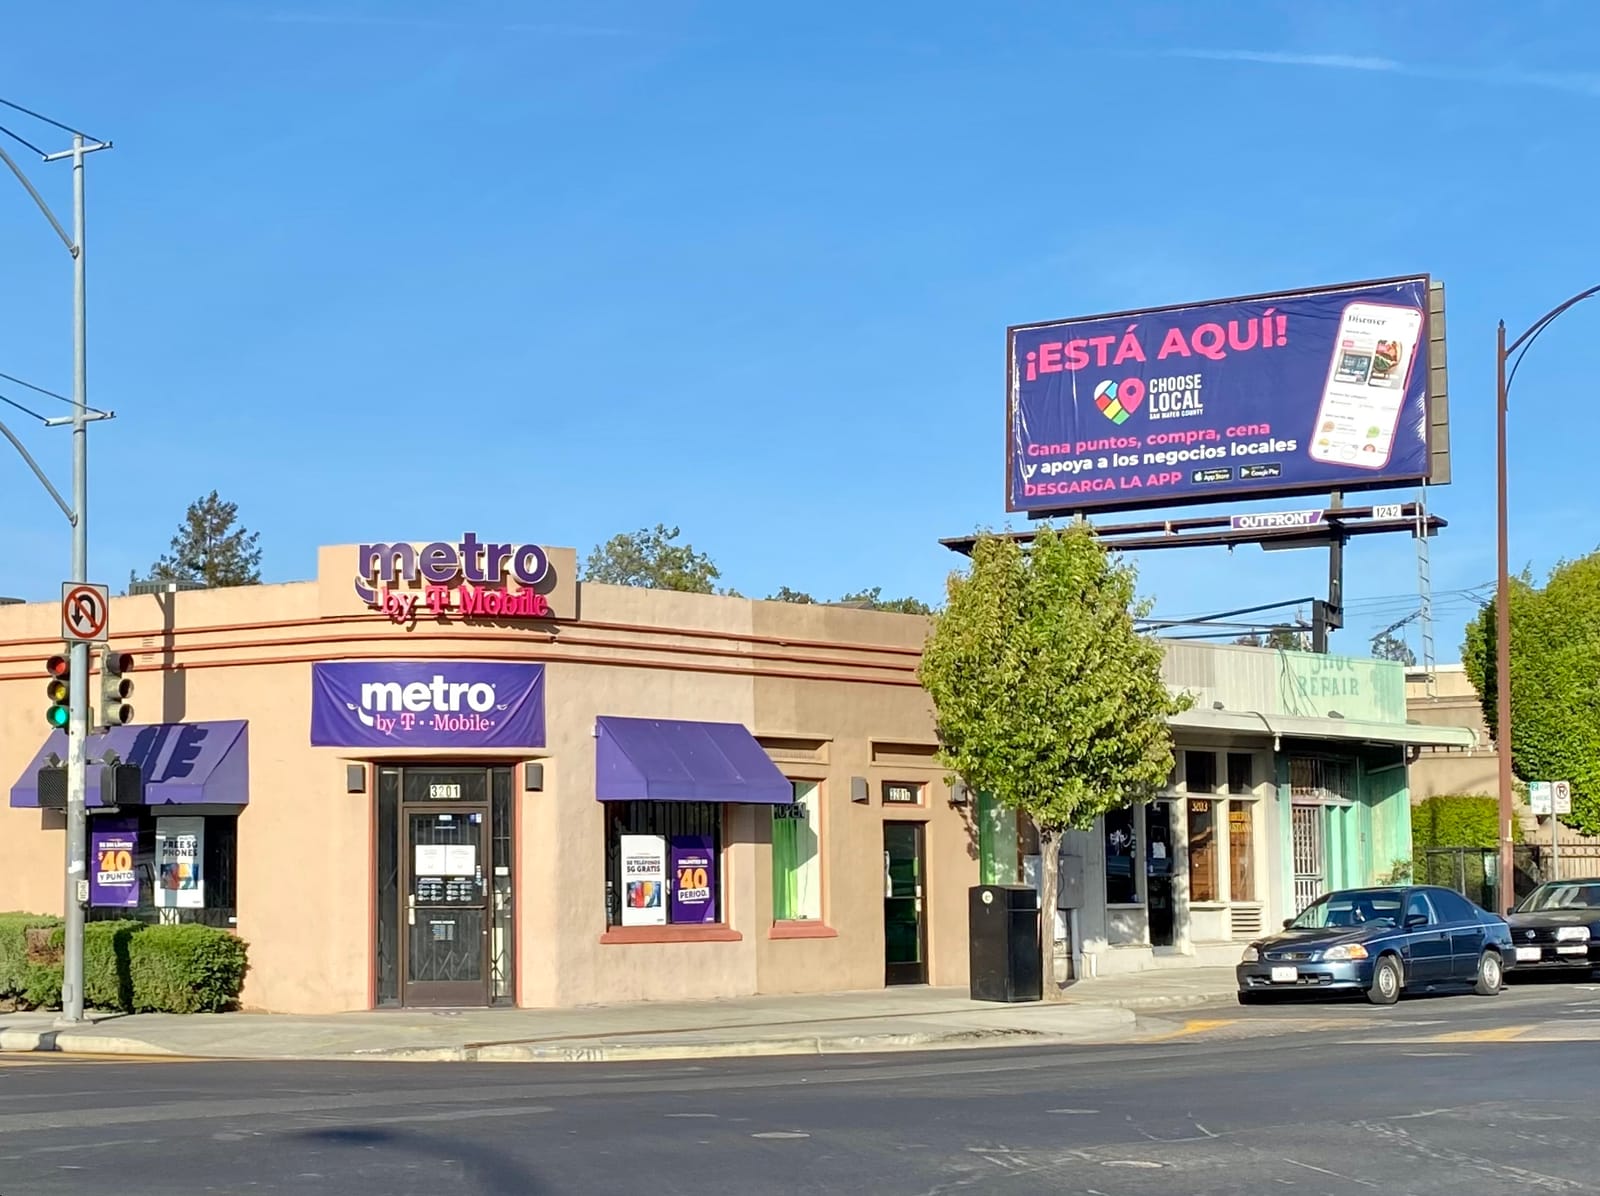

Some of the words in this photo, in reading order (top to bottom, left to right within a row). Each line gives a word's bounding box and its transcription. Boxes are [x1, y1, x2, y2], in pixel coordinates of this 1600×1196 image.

[1026, 324, 1146, 381] ¡ESTÁ
[1157, 308, 1288, 360] AQUÍ!
[1150, 374, 1202, 393] CHOOSE
[1149, 390, 1203, 412] LOCAL
[1028, 443, 1071, 457] Gana
[1076, 435, 1141, 454] puntos,
[1147, 428, 1221, 447] compra,
[1226, 423, 1271, 438] cena
[1026, 463, 1037, 478] y
[1041, 457, 1091, 477] apoya
[1098, 457, 1108, 468] a
[1113, 450, 1139, 467] los
[1143, 444, 1226, 465] negocios
[1231, 438, 1297, 456] locales
[1120, 477, 1141, 489] LA
[1146, 471, 1183, 486] APP
[1240, 512, 1314, 528] OUTFRONT
[1376, 506, 1400, 518] 1242
[358, 532, 549, 584] metro
[381, 586, 417, 622] by
[361, 675, 496, 712] metro
[376, 714, 397, 736] by
[431, 786, 460, 797] 3201
[98, 850, 132, 872] $40
[162, 849, 198, 857] PHONES
[637, 865, 661, 873] GRATIS
